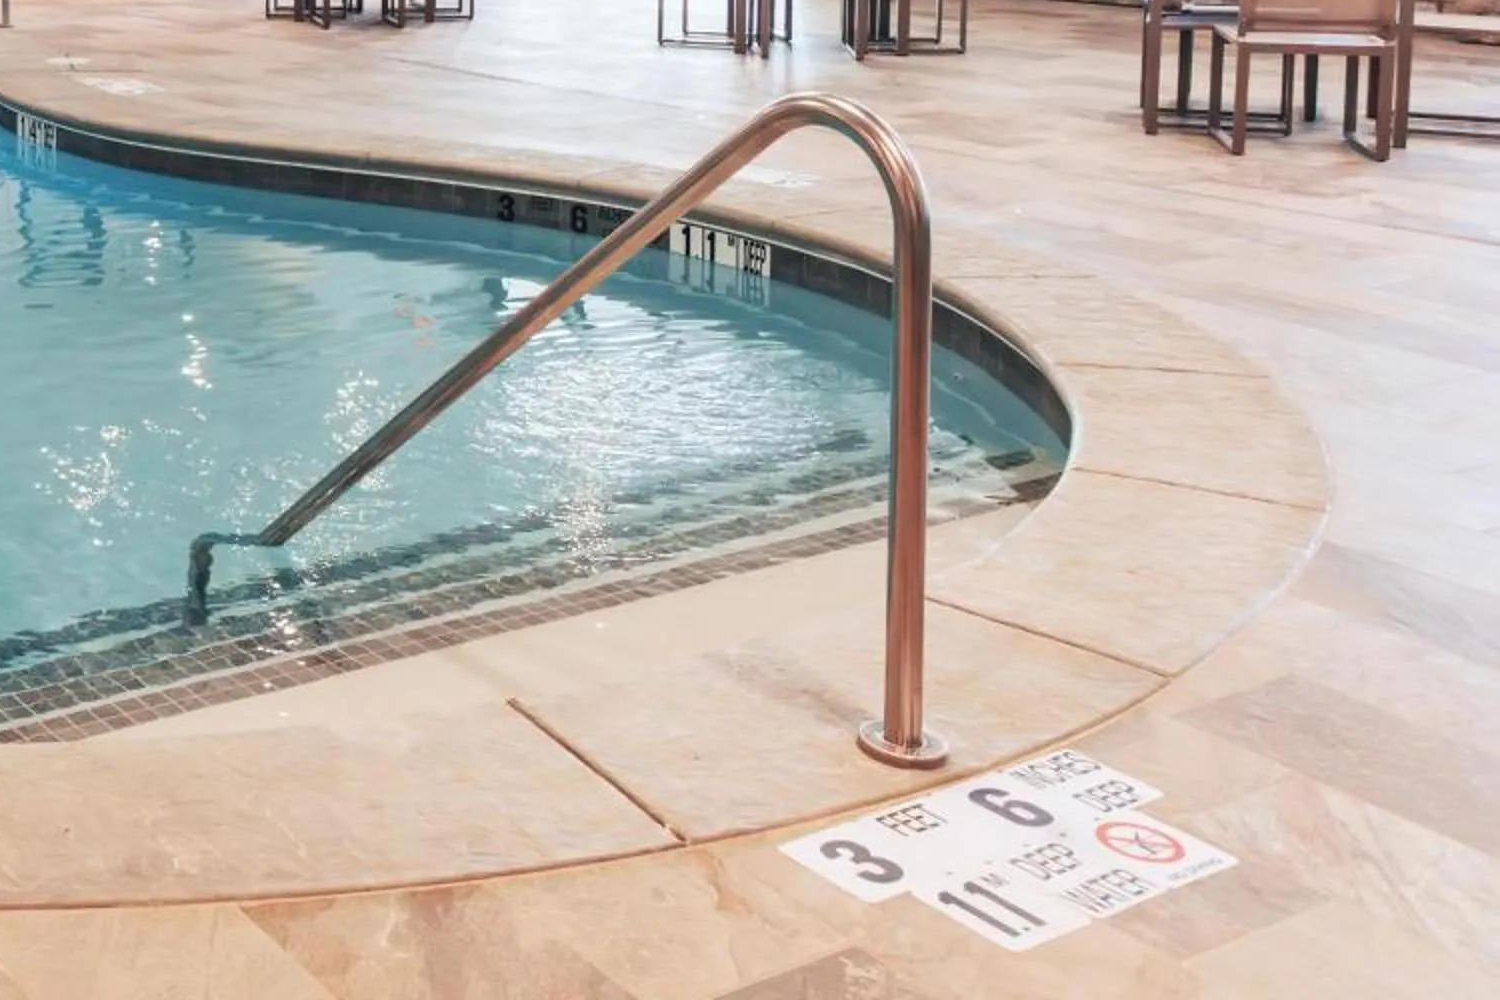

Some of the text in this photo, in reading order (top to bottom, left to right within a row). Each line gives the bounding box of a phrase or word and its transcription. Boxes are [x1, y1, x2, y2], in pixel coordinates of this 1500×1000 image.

[1072, 779, 1142, 813] DEEP
[819, 839, 904, 885] 3
[874, 803, 948, 837] FEET
[967, 787, 1055, 828] 6
[1010, 842, 1088, 881] DEEP
[1061, 868, 1157, 915] WATER
